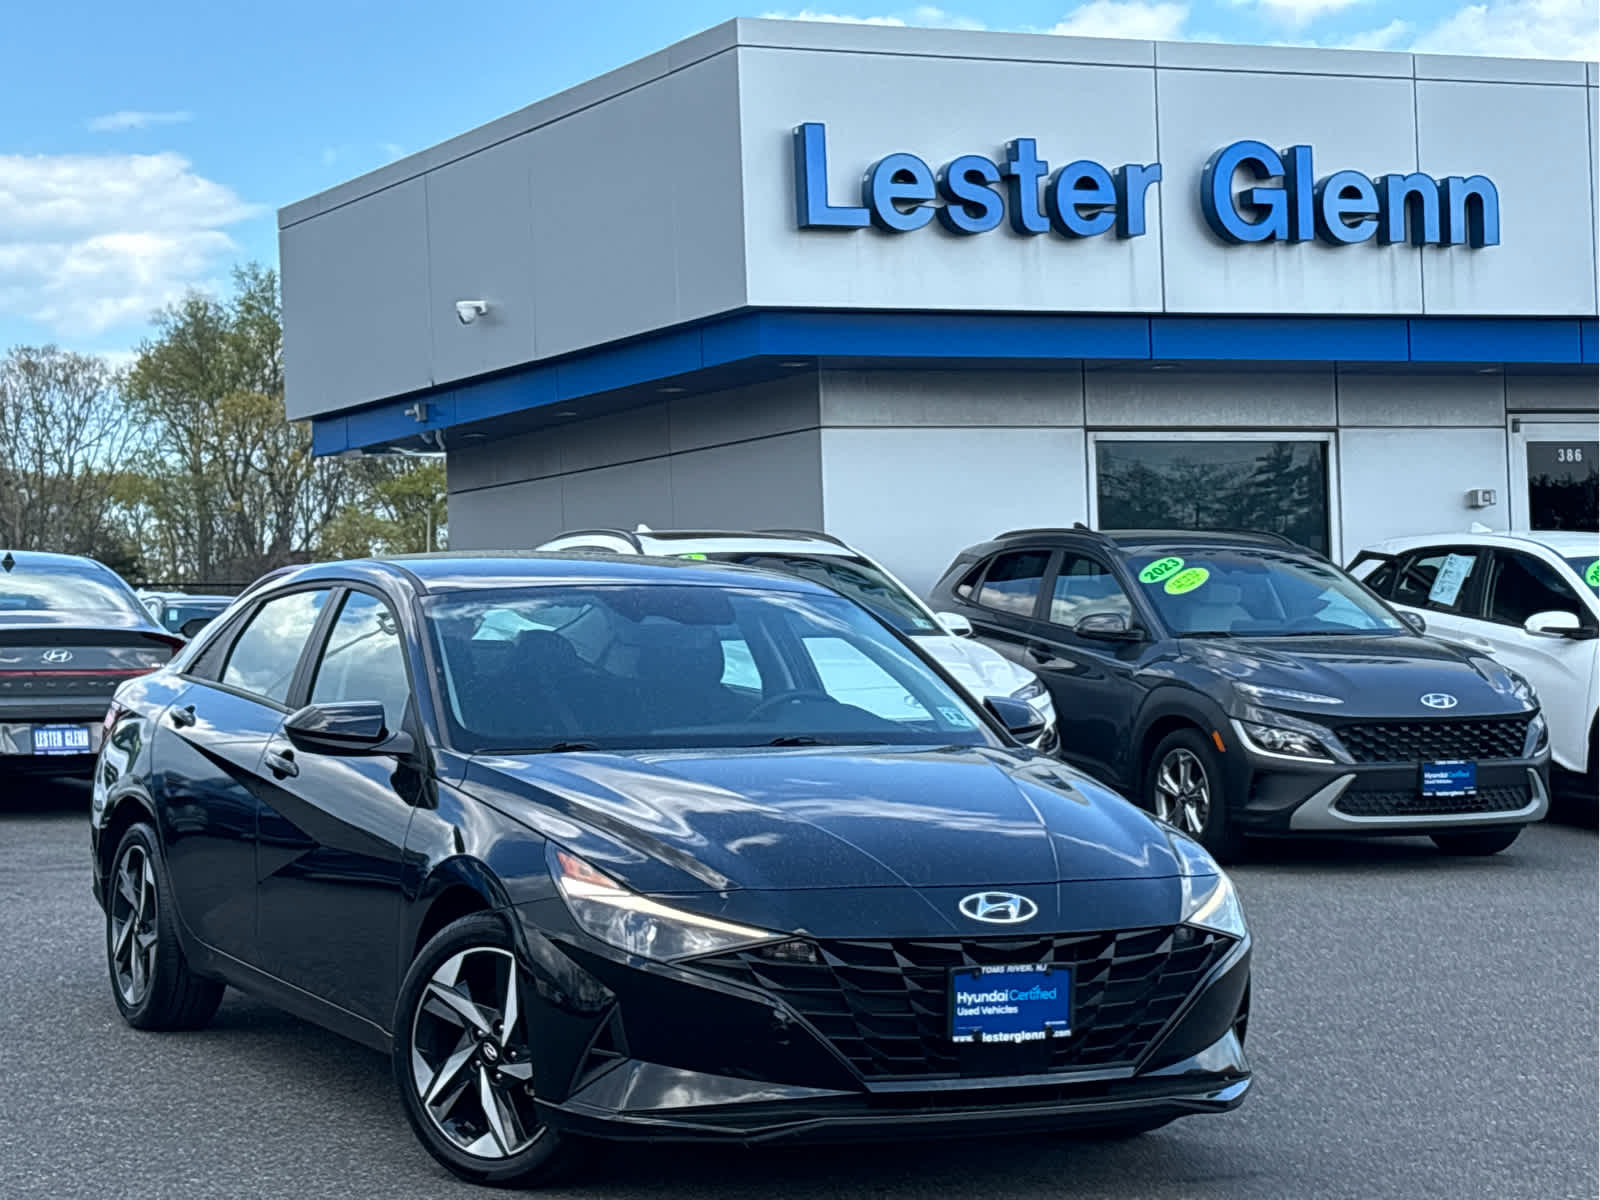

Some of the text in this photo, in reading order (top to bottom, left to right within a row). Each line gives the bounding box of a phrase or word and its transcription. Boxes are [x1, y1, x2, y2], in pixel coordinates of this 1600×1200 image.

[793, 122, 1500, 248] Lester Glenn
[1558, 448, 1582, 462] 386
[1144, 558, 1180, 580] 2023
[35, 730, 62, 747] LESTER
[981, 965, 1005, 974] TOMS
[956, 986, 1057, 1006] Hyundai Certified
[956, 1004, 1019, 1016] Used Vehicles
[982, 1030, 1046, 1044] lesterglenn
